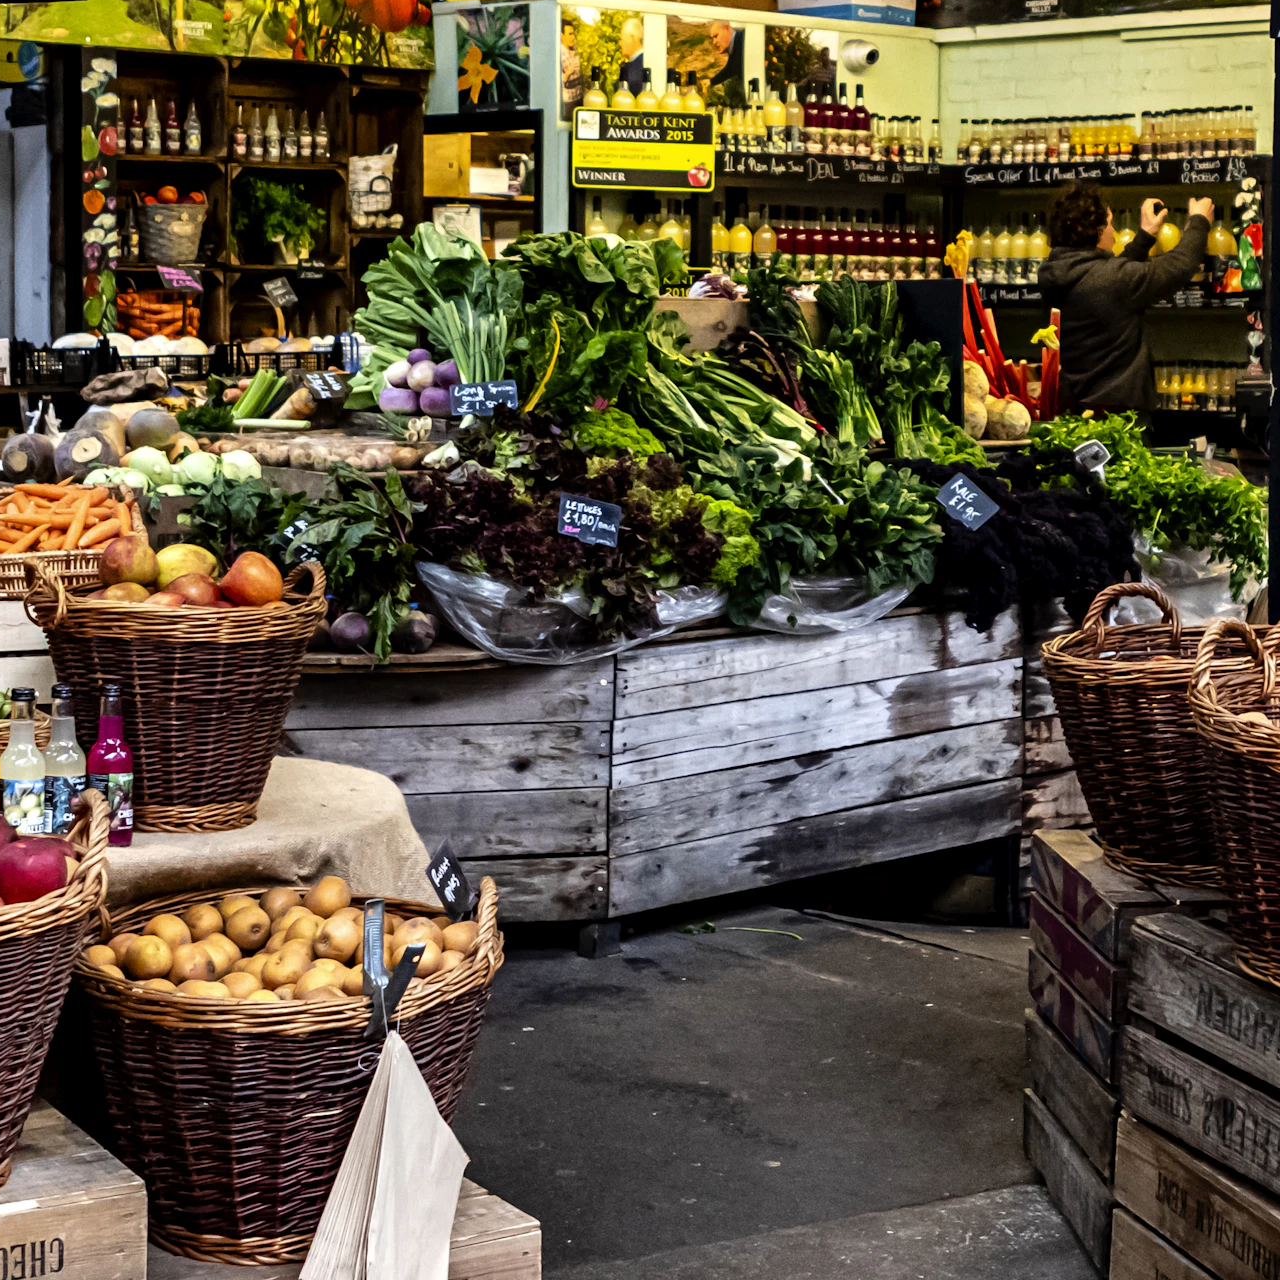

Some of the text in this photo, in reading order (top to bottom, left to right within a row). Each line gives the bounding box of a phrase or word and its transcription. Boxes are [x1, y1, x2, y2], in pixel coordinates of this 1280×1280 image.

[666, 130, 694, 141] 2015
[807, 157, 840, 181] DEAL
[1109, 162, 1117, 176] 3
[1183, 161, 1190, 171] 6
[1181, 172, 1190, 183] 12
[950, 478, 978, 503] KALE
[565, 500, 602, 516] LETTUCES
[1155, 1172, 1188, 1216] KENT
